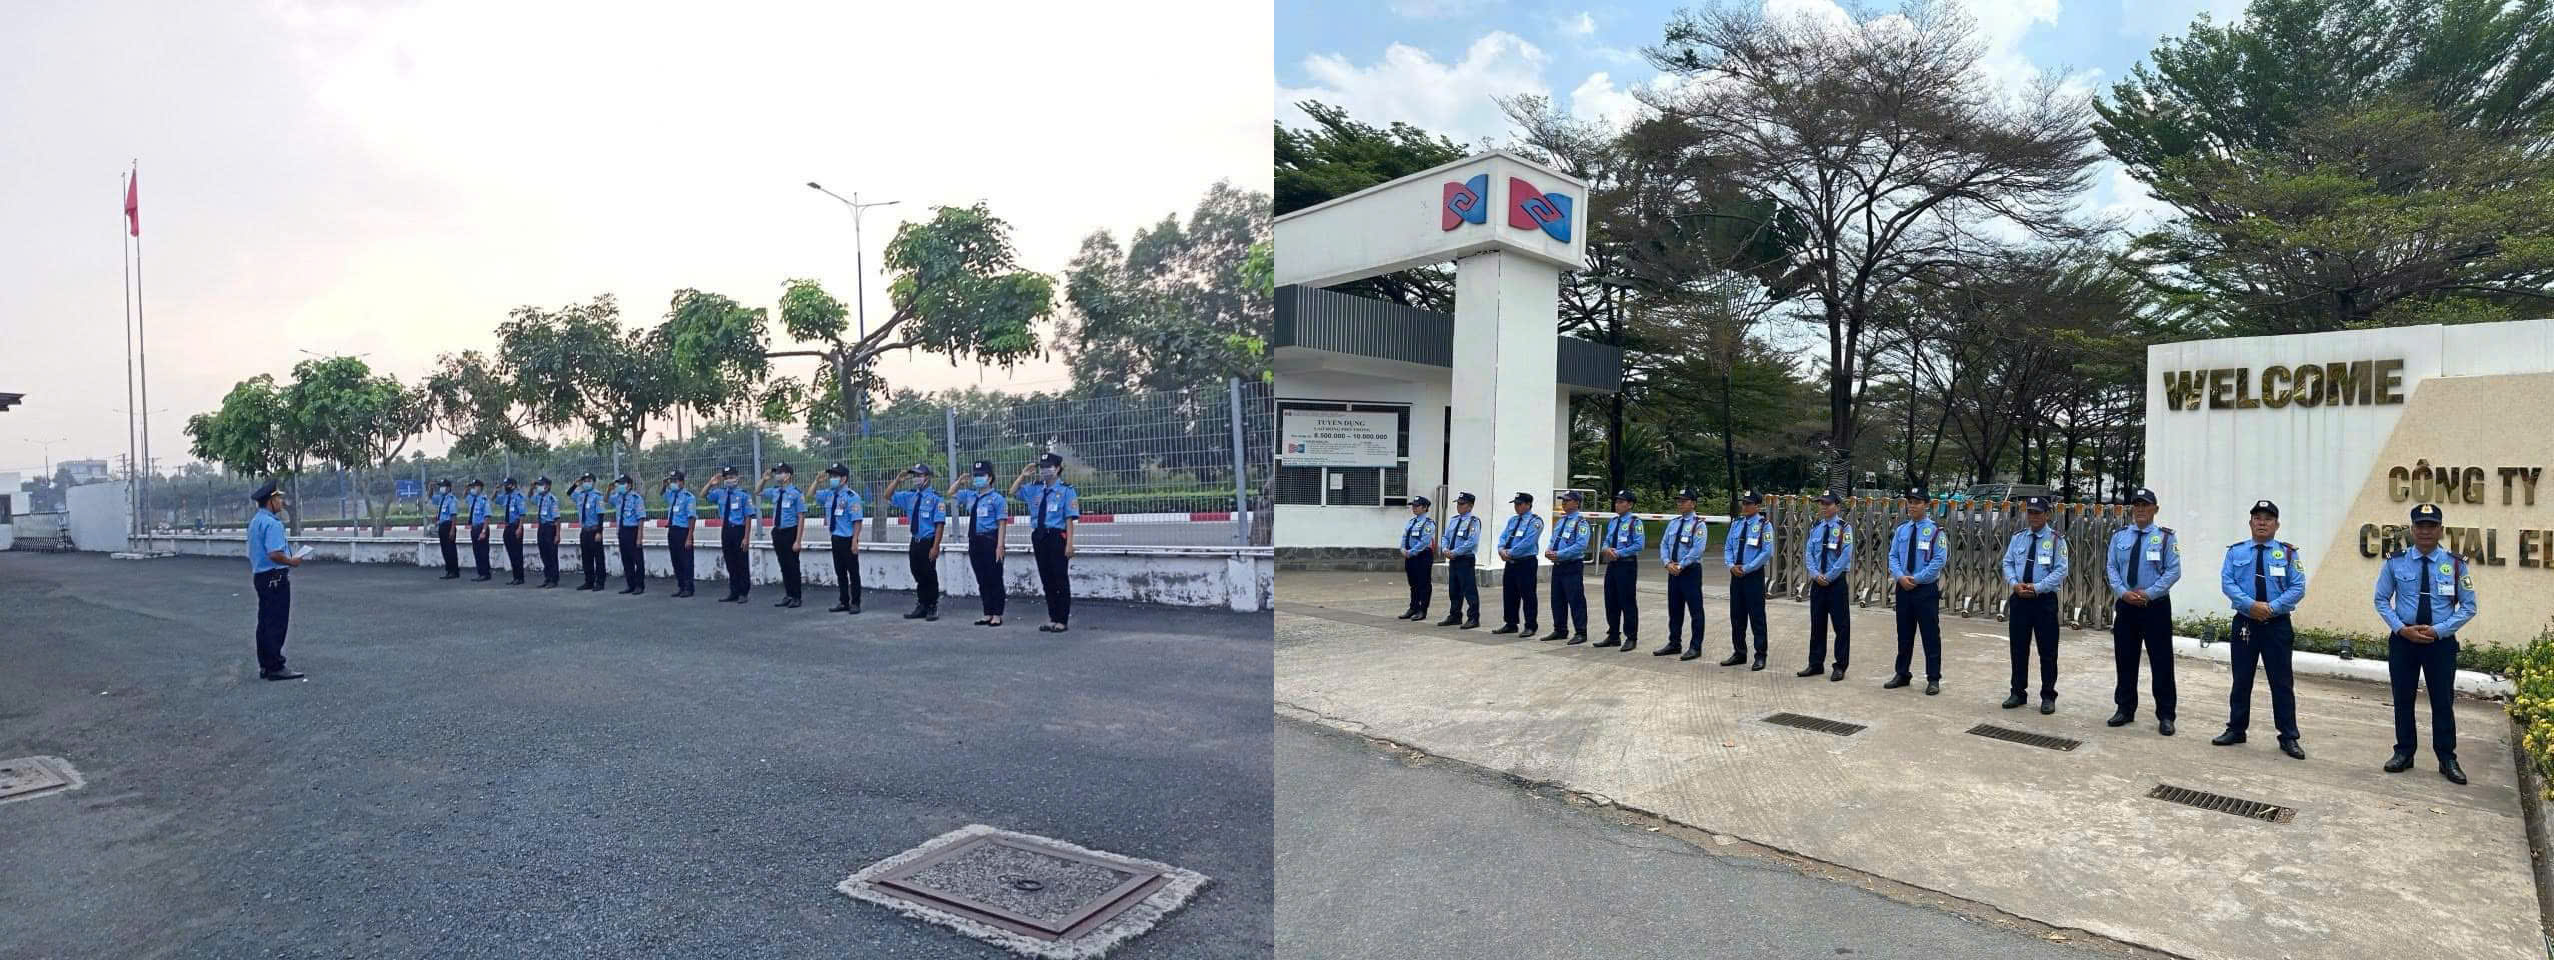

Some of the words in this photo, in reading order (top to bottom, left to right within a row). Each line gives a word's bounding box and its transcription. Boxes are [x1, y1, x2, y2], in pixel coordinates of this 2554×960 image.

[2163, 359, 2404, 411] WELCOME
[2388, 459, 2485, 504] CÔNG
[2498, 467, 2542, 505] TY
